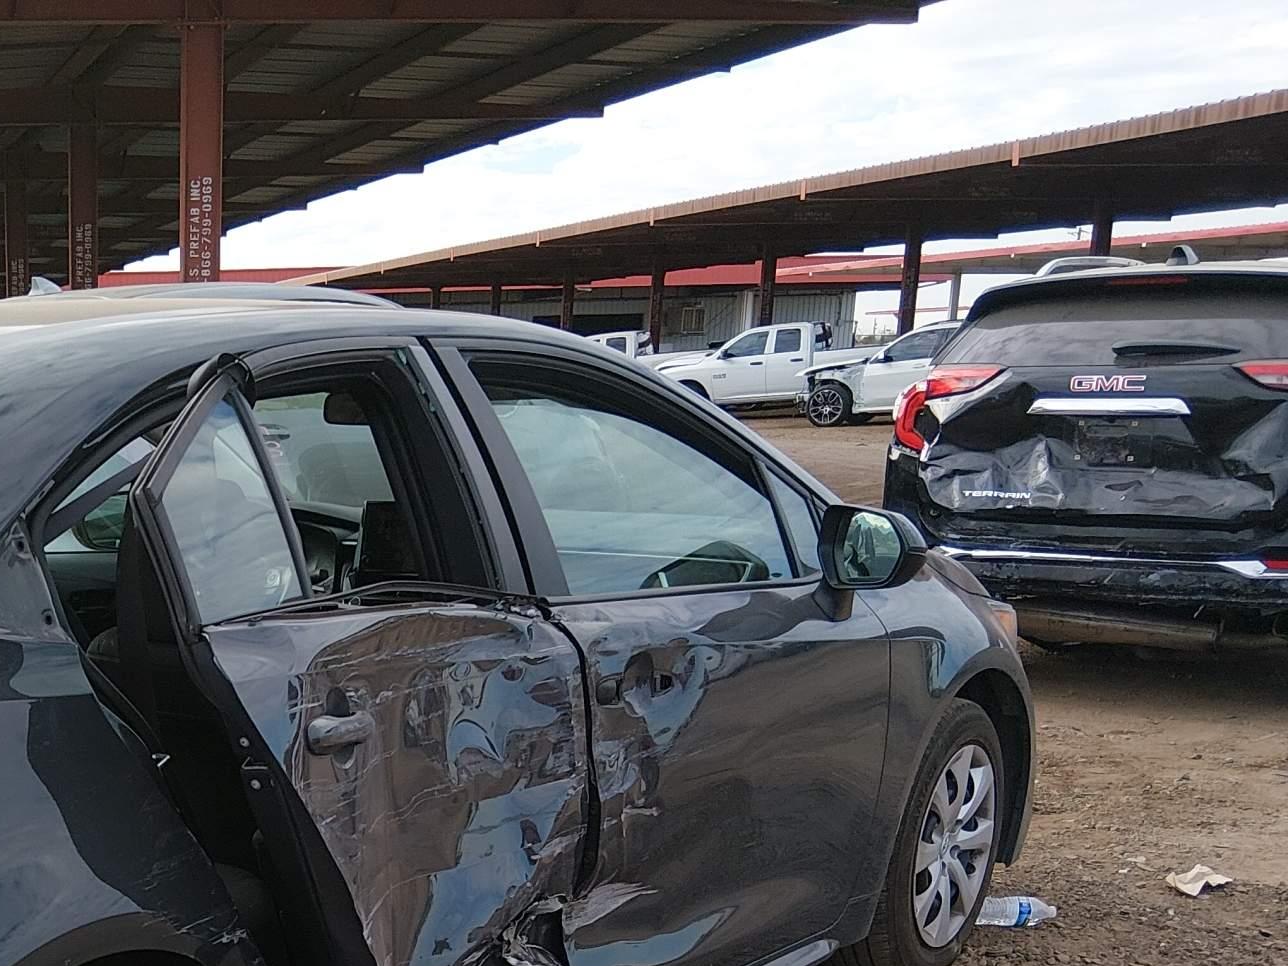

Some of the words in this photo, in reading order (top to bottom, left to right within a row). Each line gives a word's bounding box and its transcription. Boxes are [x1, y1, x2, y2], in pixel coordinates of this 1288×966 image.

[190, 175, 201, 201] INC.
[190, 207, 200, 258] PREFAB
[1070, 375, 1146, 392] GMC
[962, 490, 1031, 499] TERRAIN
